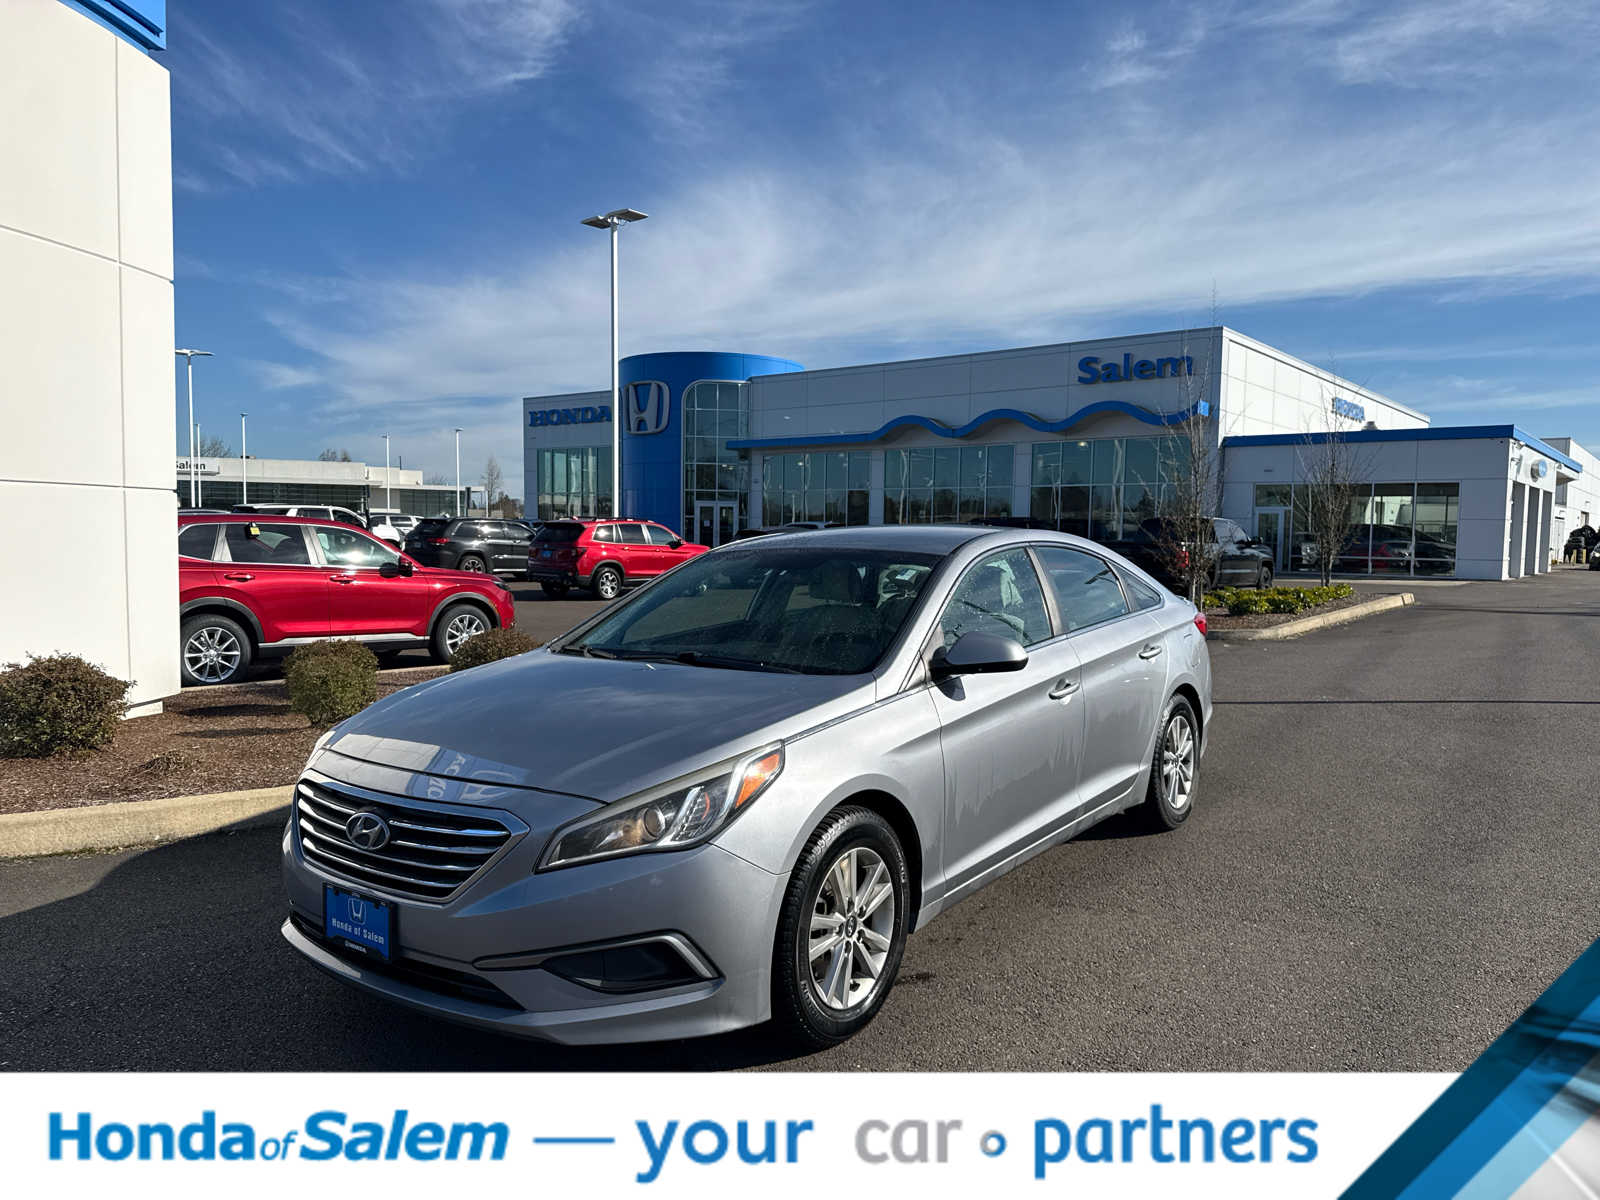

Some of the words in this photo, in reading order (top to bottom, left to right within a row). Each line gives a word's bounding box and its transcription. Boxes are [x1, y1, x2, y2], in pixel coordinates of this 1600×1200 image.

[1078, 352, 1193, 384] Salem
[528, 405, 613, 427] HONDA
[332, 917, 352, 933] Honda
[354, 928, 361, 937] of
[363, 929, 385, 945] Salem
